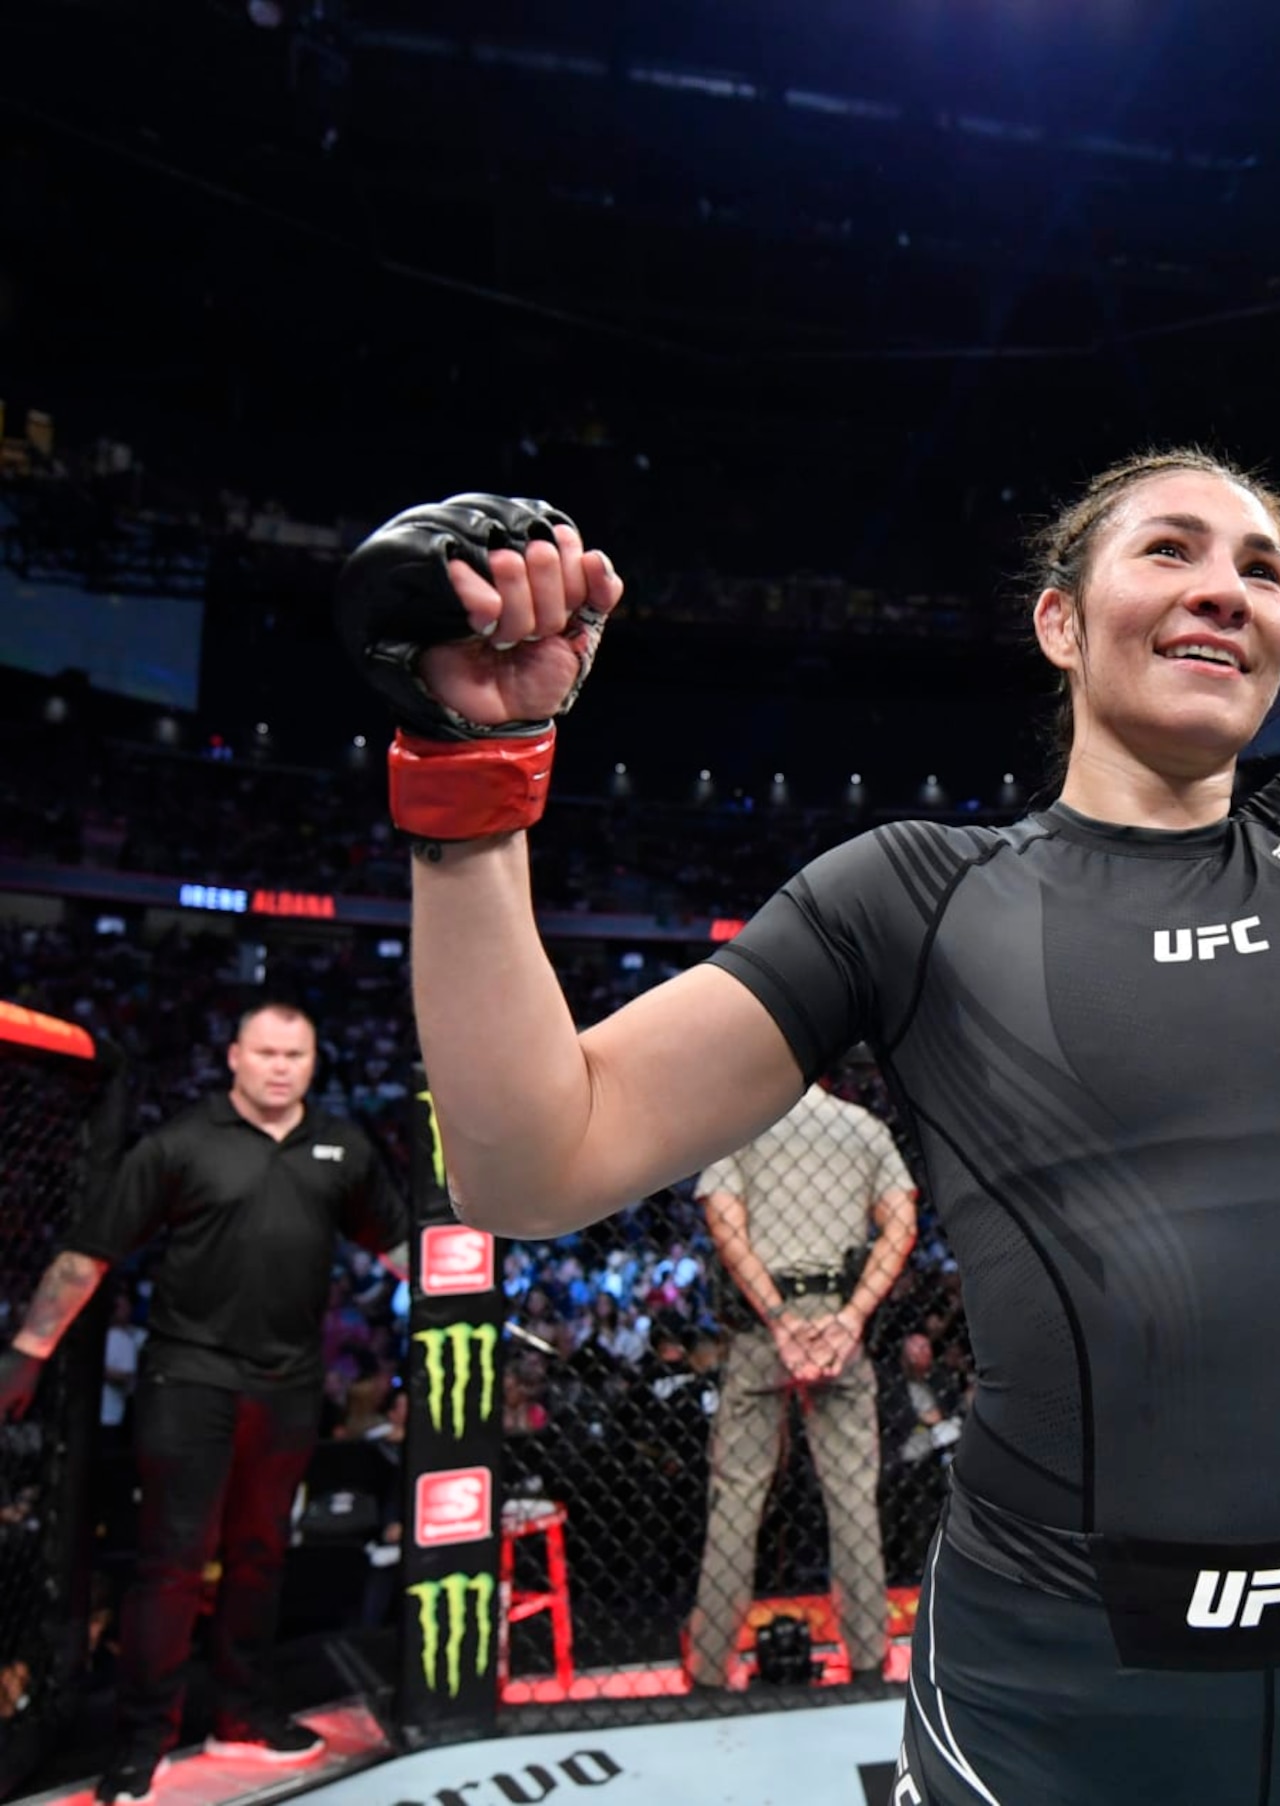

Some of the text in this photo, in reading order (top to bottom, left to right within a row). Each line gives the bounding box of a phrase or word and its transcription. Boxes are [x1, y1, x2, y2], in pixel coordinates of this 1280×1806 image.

[180, 884, 335, 919] IRENE ALDANA
[1153, 915, 1270, 962] UFC
